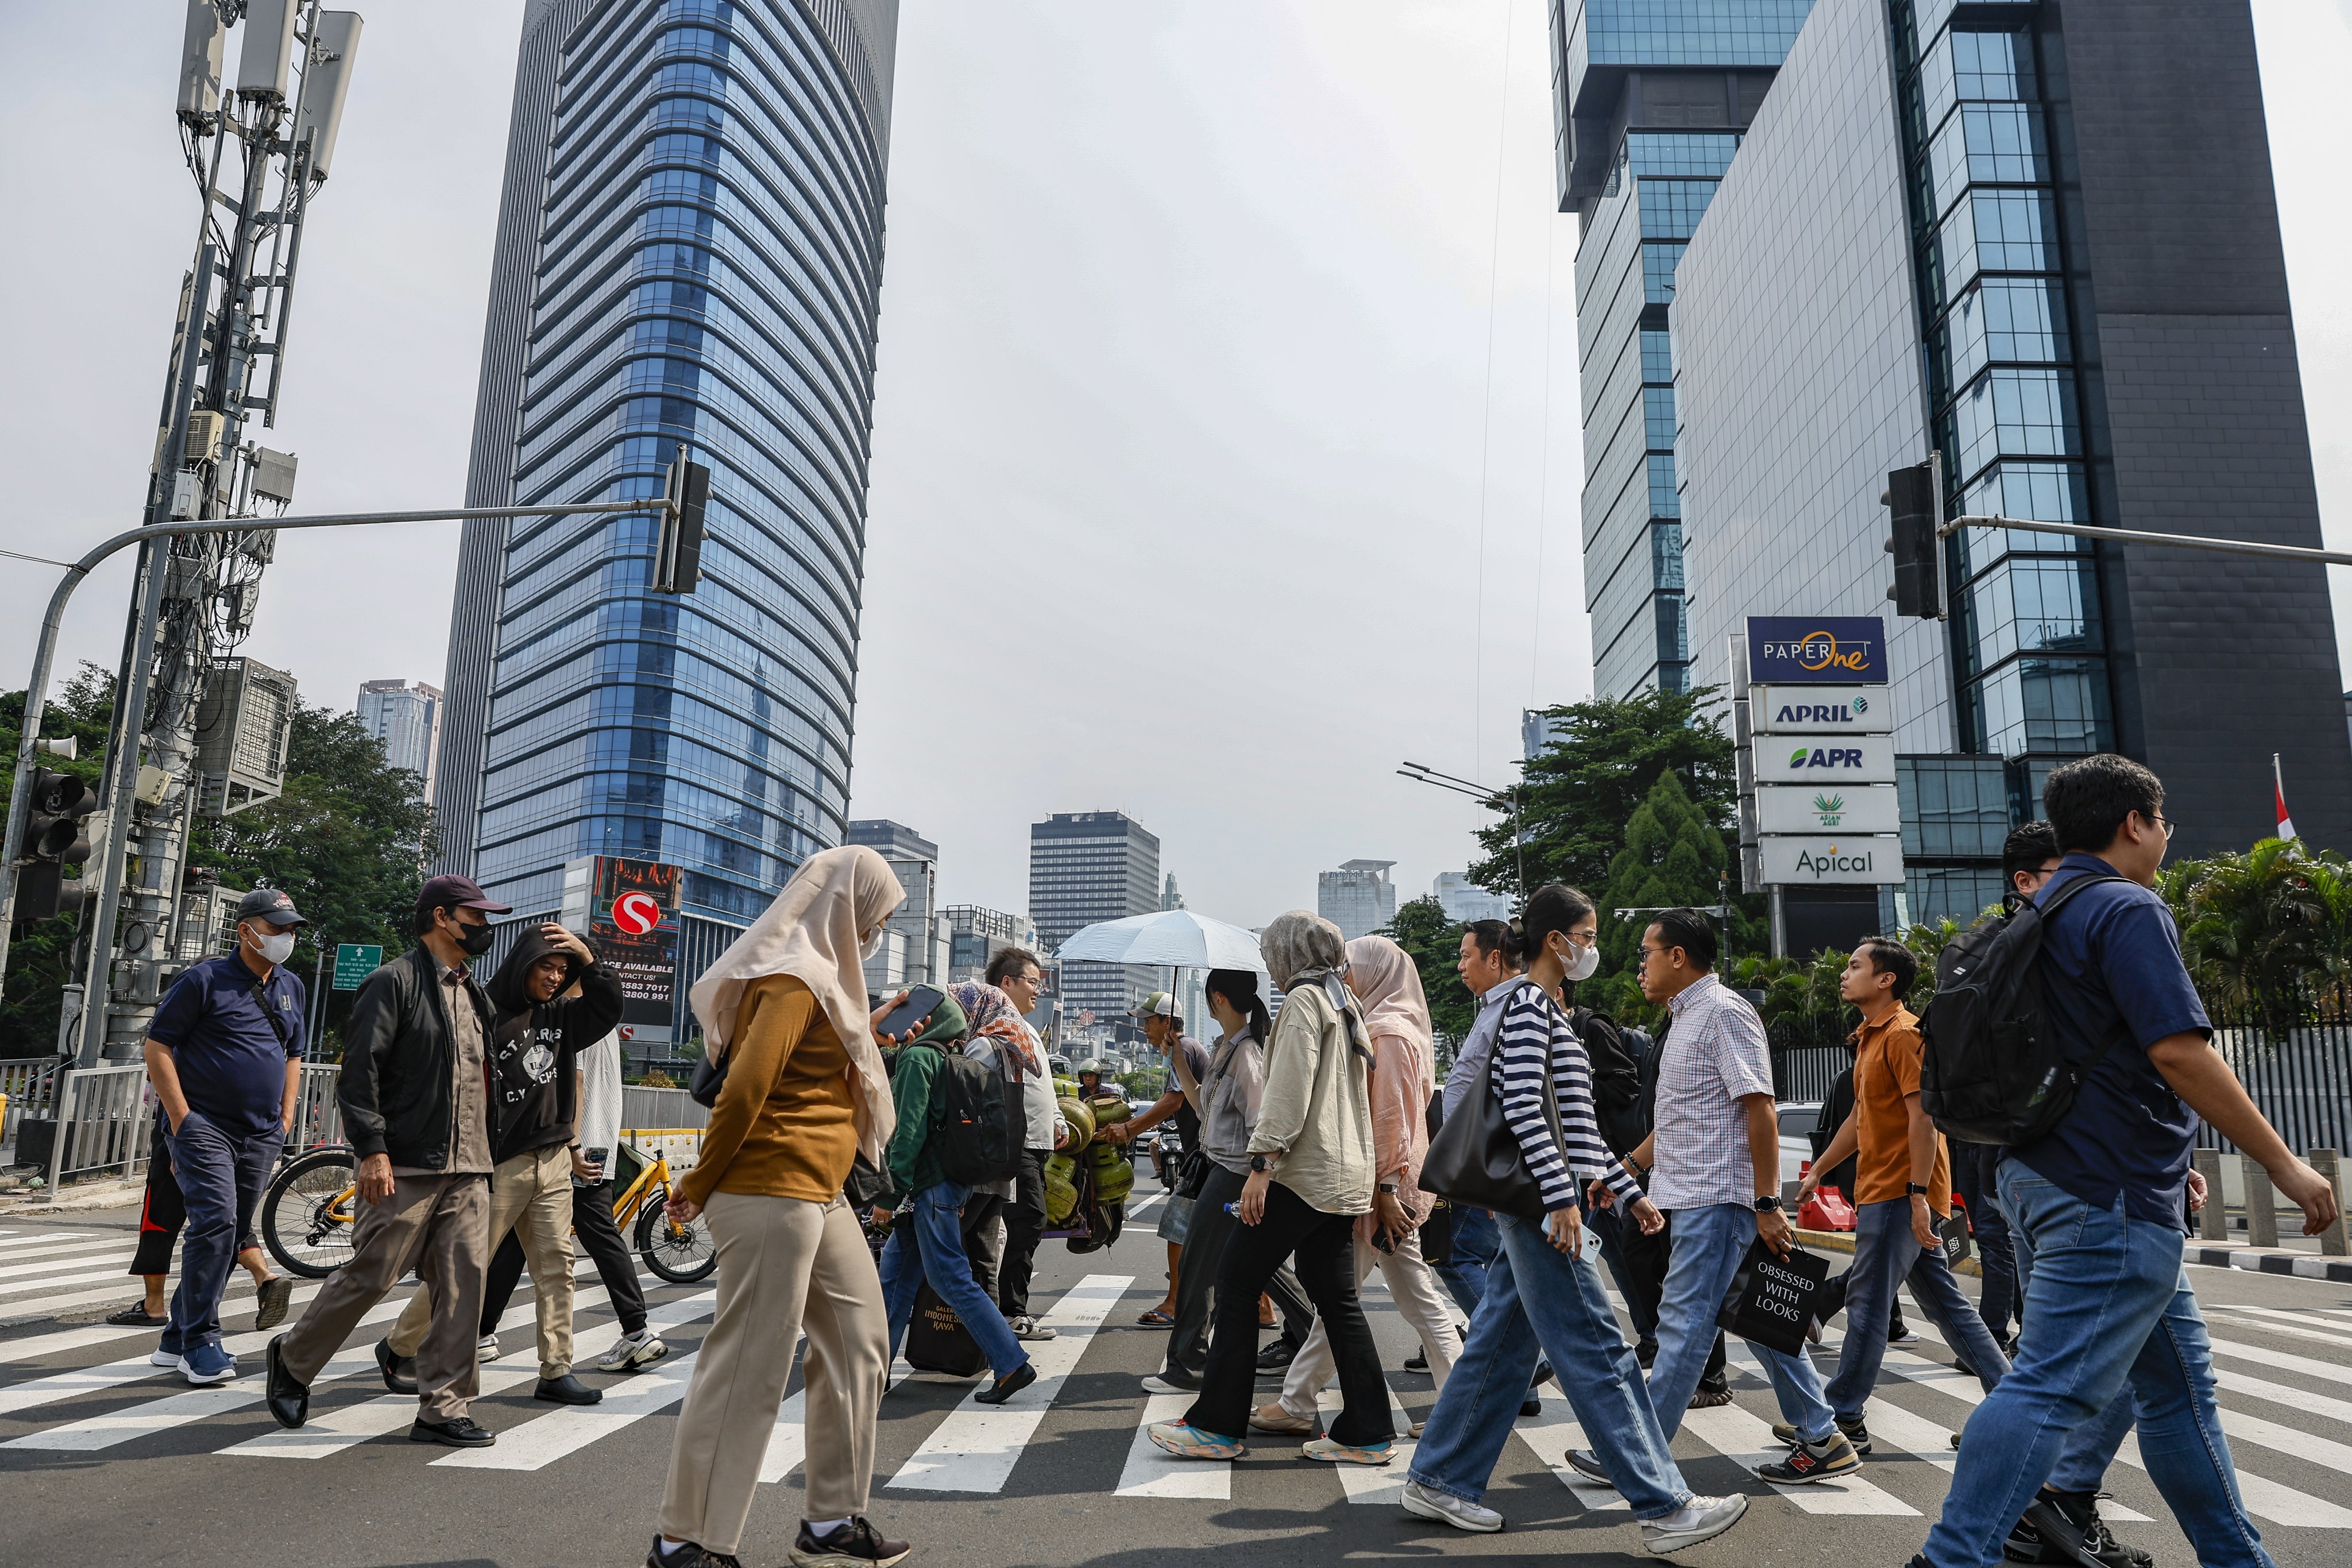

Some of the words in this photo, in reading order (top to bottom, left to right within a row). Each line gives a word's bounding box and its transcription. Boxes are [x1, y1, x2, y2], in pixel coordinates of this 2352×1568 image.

[1764, 644, 1830, 659] PAPER
[1799, 631, 1870, 670] One
[1775, 705, 1853, 722] APRIL
[1807, 748, 1863, 767] APR
[1795, 847, 1872, 879] Apical
[623, 963, 674, 973] AVAILABLE
[646, 984, 669, 992] 7017
[1758, 1262, 1814, 1291] OBSESSED
[1766, 1280, 1799, 1304] WITH
[936, 1306, 954, 1314] GALER
[1756, 1295, 1799, 1321] LOOKS
[933, 1321, 954, 1331] KAYA
